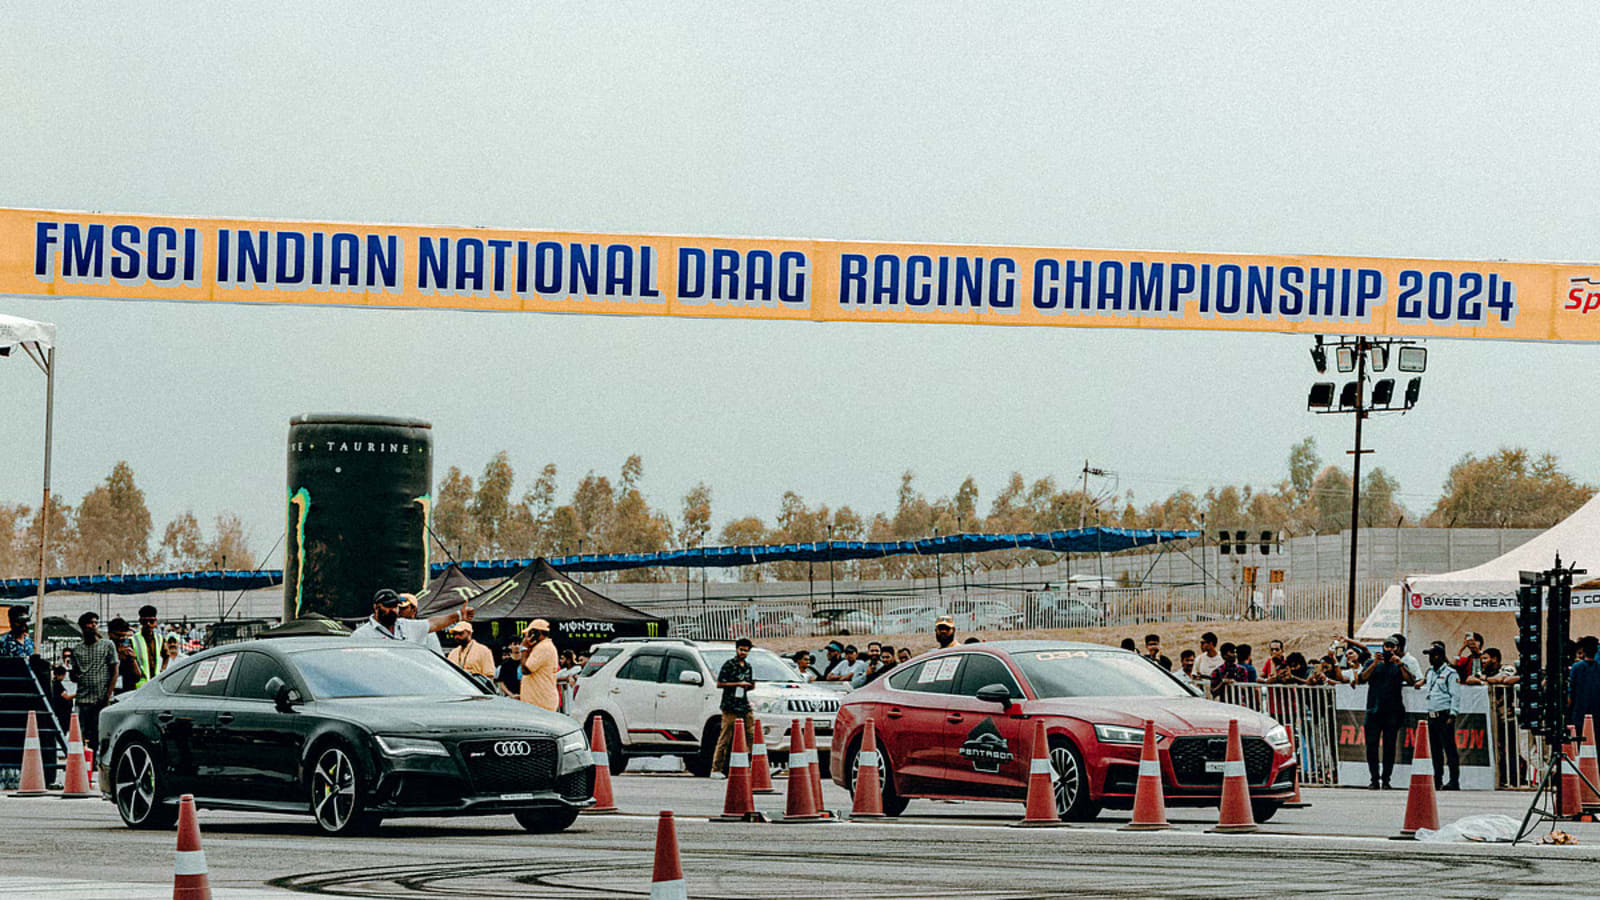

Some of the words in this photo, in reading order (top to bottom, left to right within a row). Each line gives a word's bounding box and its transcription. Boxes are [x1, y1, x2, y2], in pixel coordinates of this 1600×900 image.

[35, 221, 198, 283] FMSCI
[217, 228, 398, 289] INDIAN
[417, 236, 660, 298] NATIONAL
[677, 247, 808, 304] DRAG
[839, 253, 1018, 309] RACING
[1032, 258, 1383, 319] CHAMPIONSHIP
[1396, 269, 1515, 323] 2024
[327, 441, 409, 455] TAURINE
[1424, 596, 1468, 608] SWEET
[559, 620, 616, 633] MONSTER
